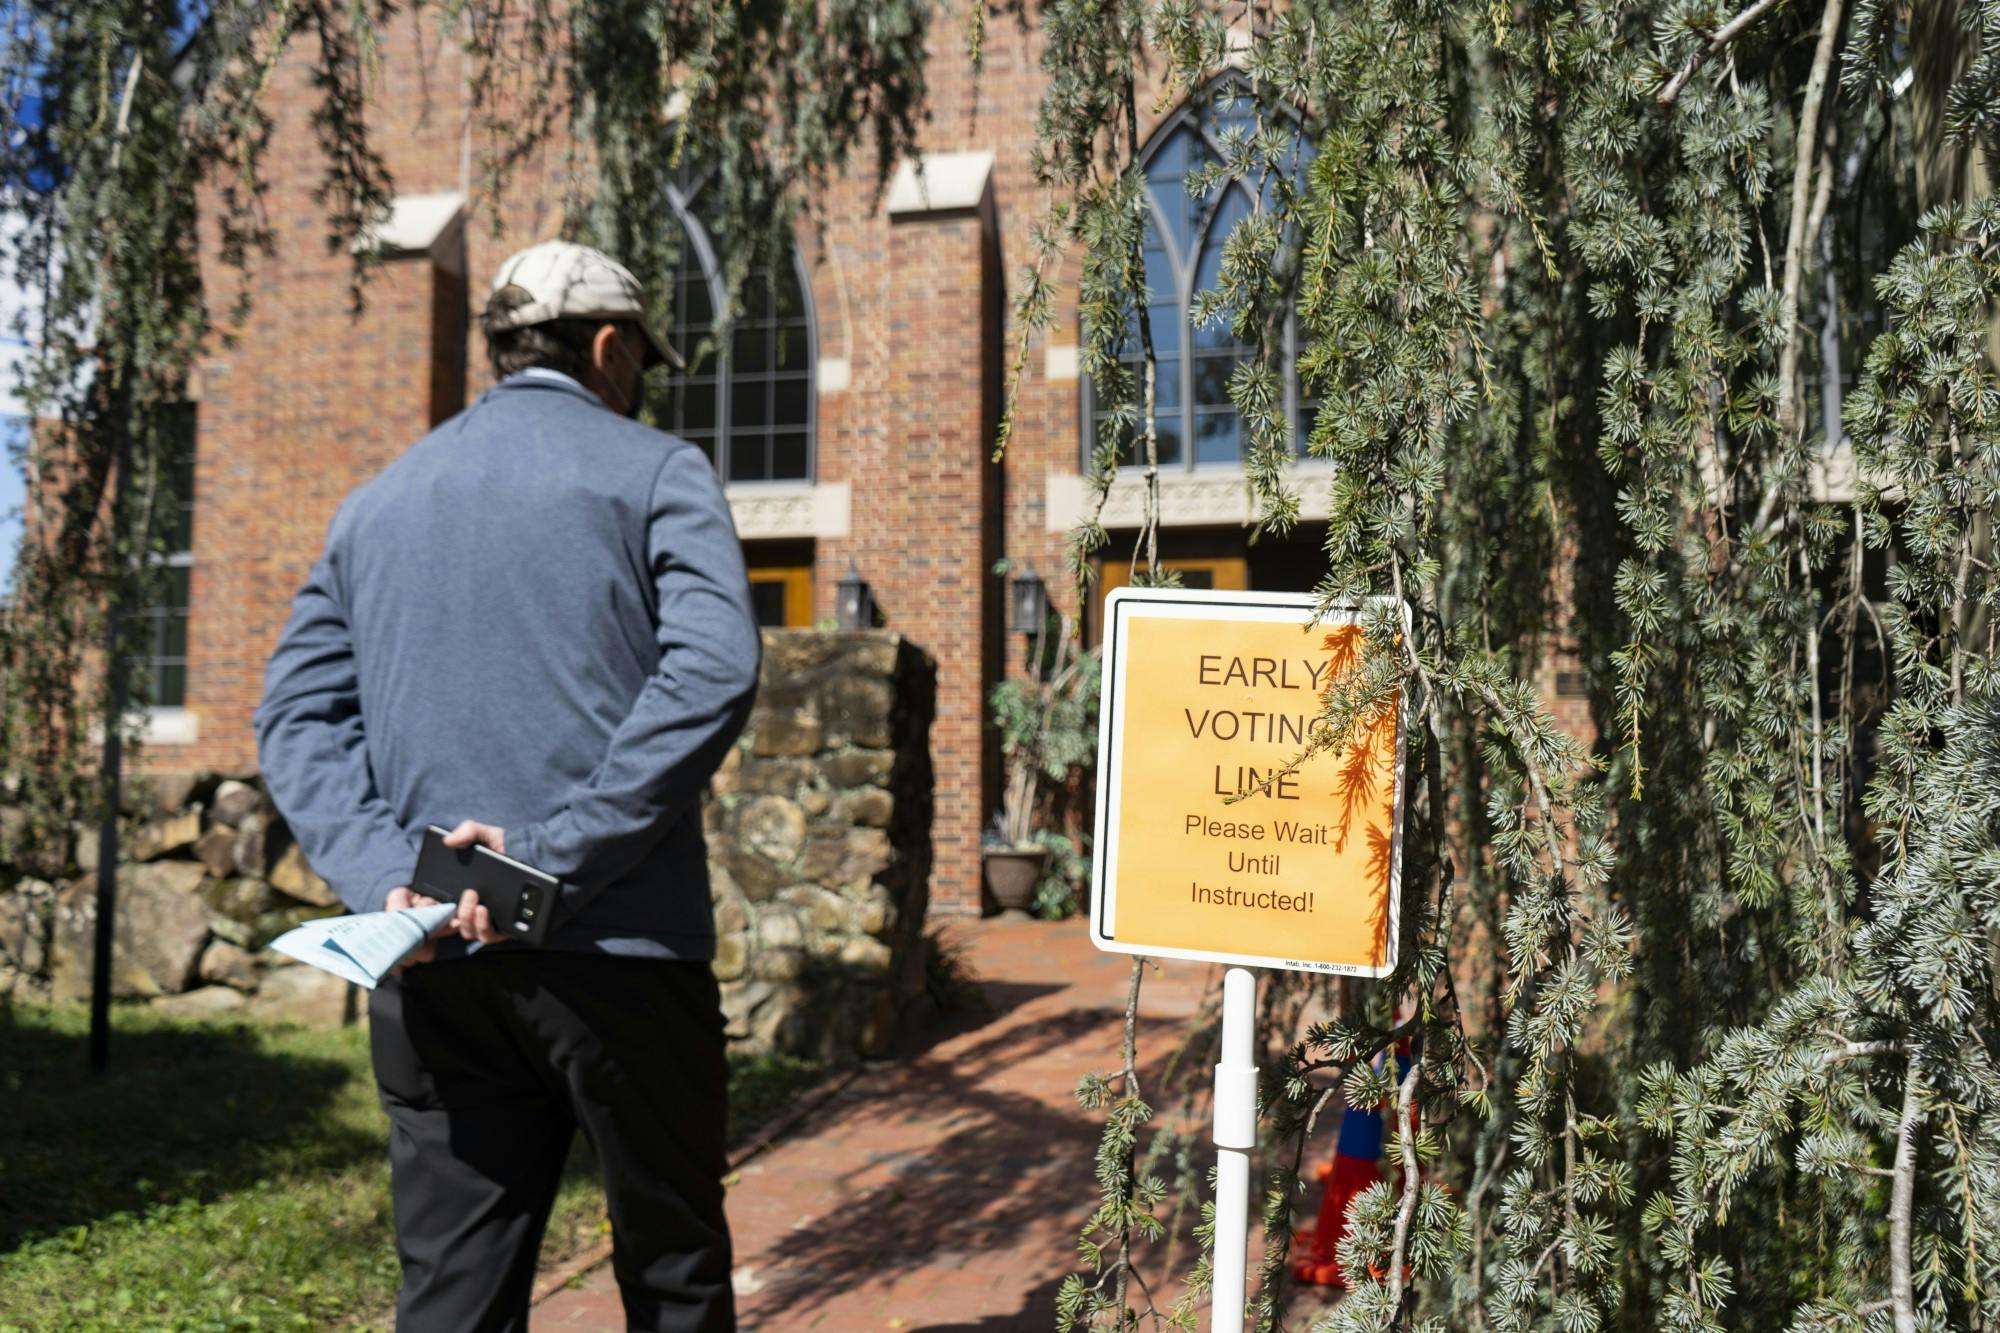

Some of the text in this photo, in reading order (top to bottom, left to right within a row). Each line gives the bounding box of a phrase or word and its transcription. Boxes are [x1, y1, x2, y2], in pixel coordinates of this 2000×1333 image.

[1199, 655, 1328, 690] EARLY
[1215, 765, 1300, 800] LINE
[1186, 815, 1328, 845] Please Wait
[1229, 851, 1280, 875] Until
[1192, 882, 1314, 912] Instructed!
